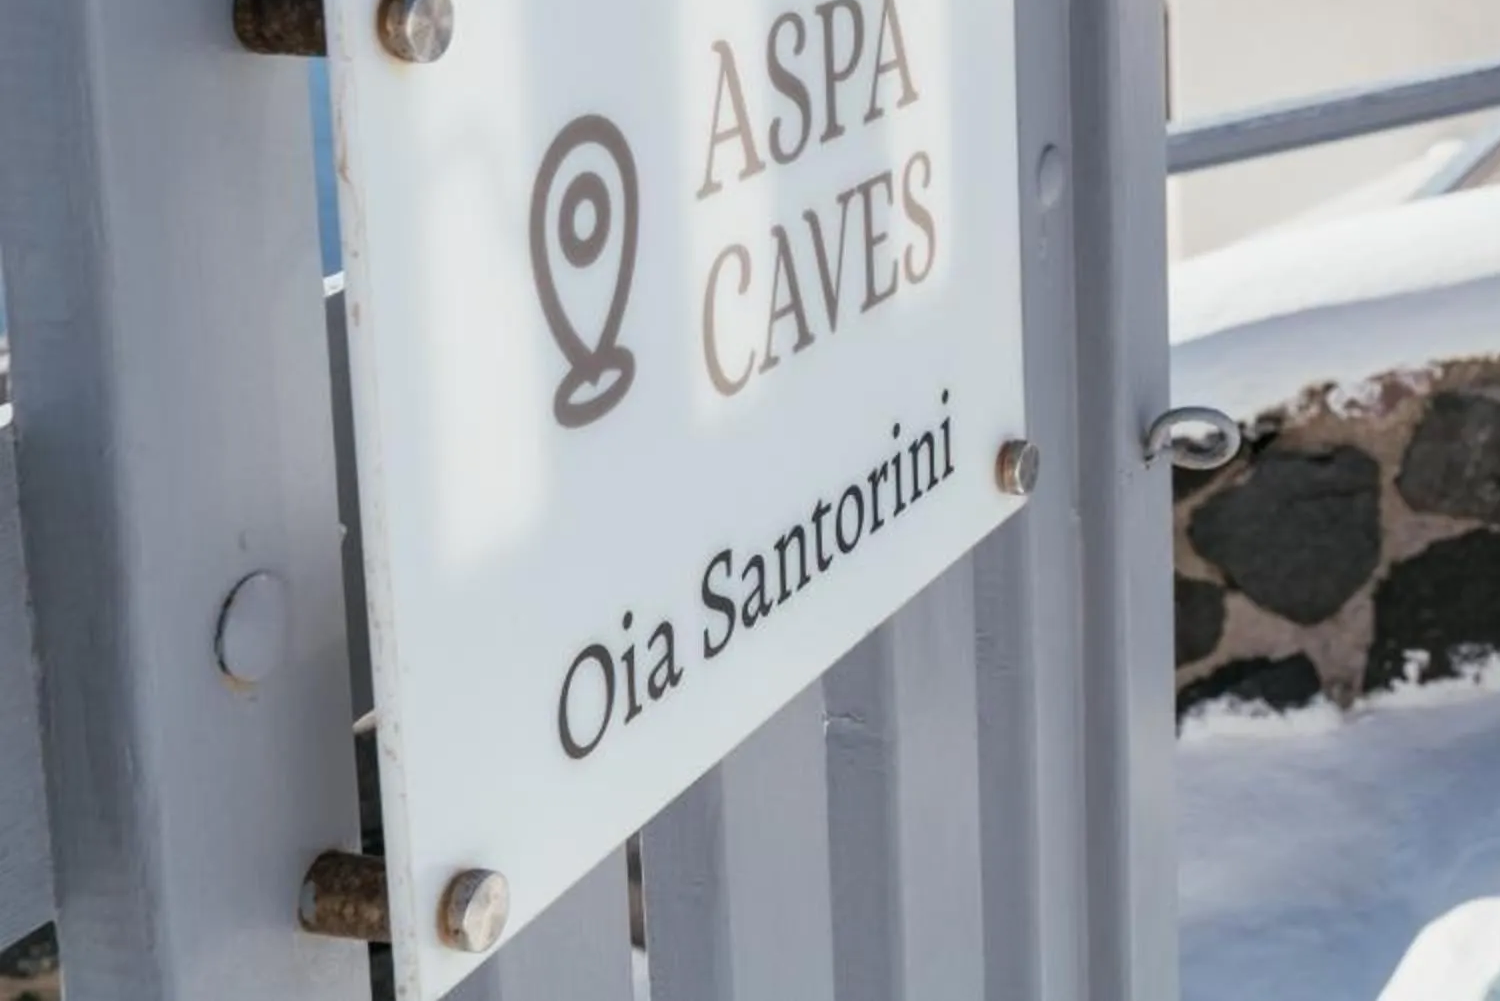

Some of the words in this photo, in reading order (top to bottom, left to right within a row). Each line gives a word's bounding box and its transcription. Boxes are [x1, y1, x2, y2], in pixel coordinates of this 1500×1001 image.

[701, 150, 937, 398] CAVES
[557, 611, 683, 761] Oia
[702, 389, 955, 661] Santorini
